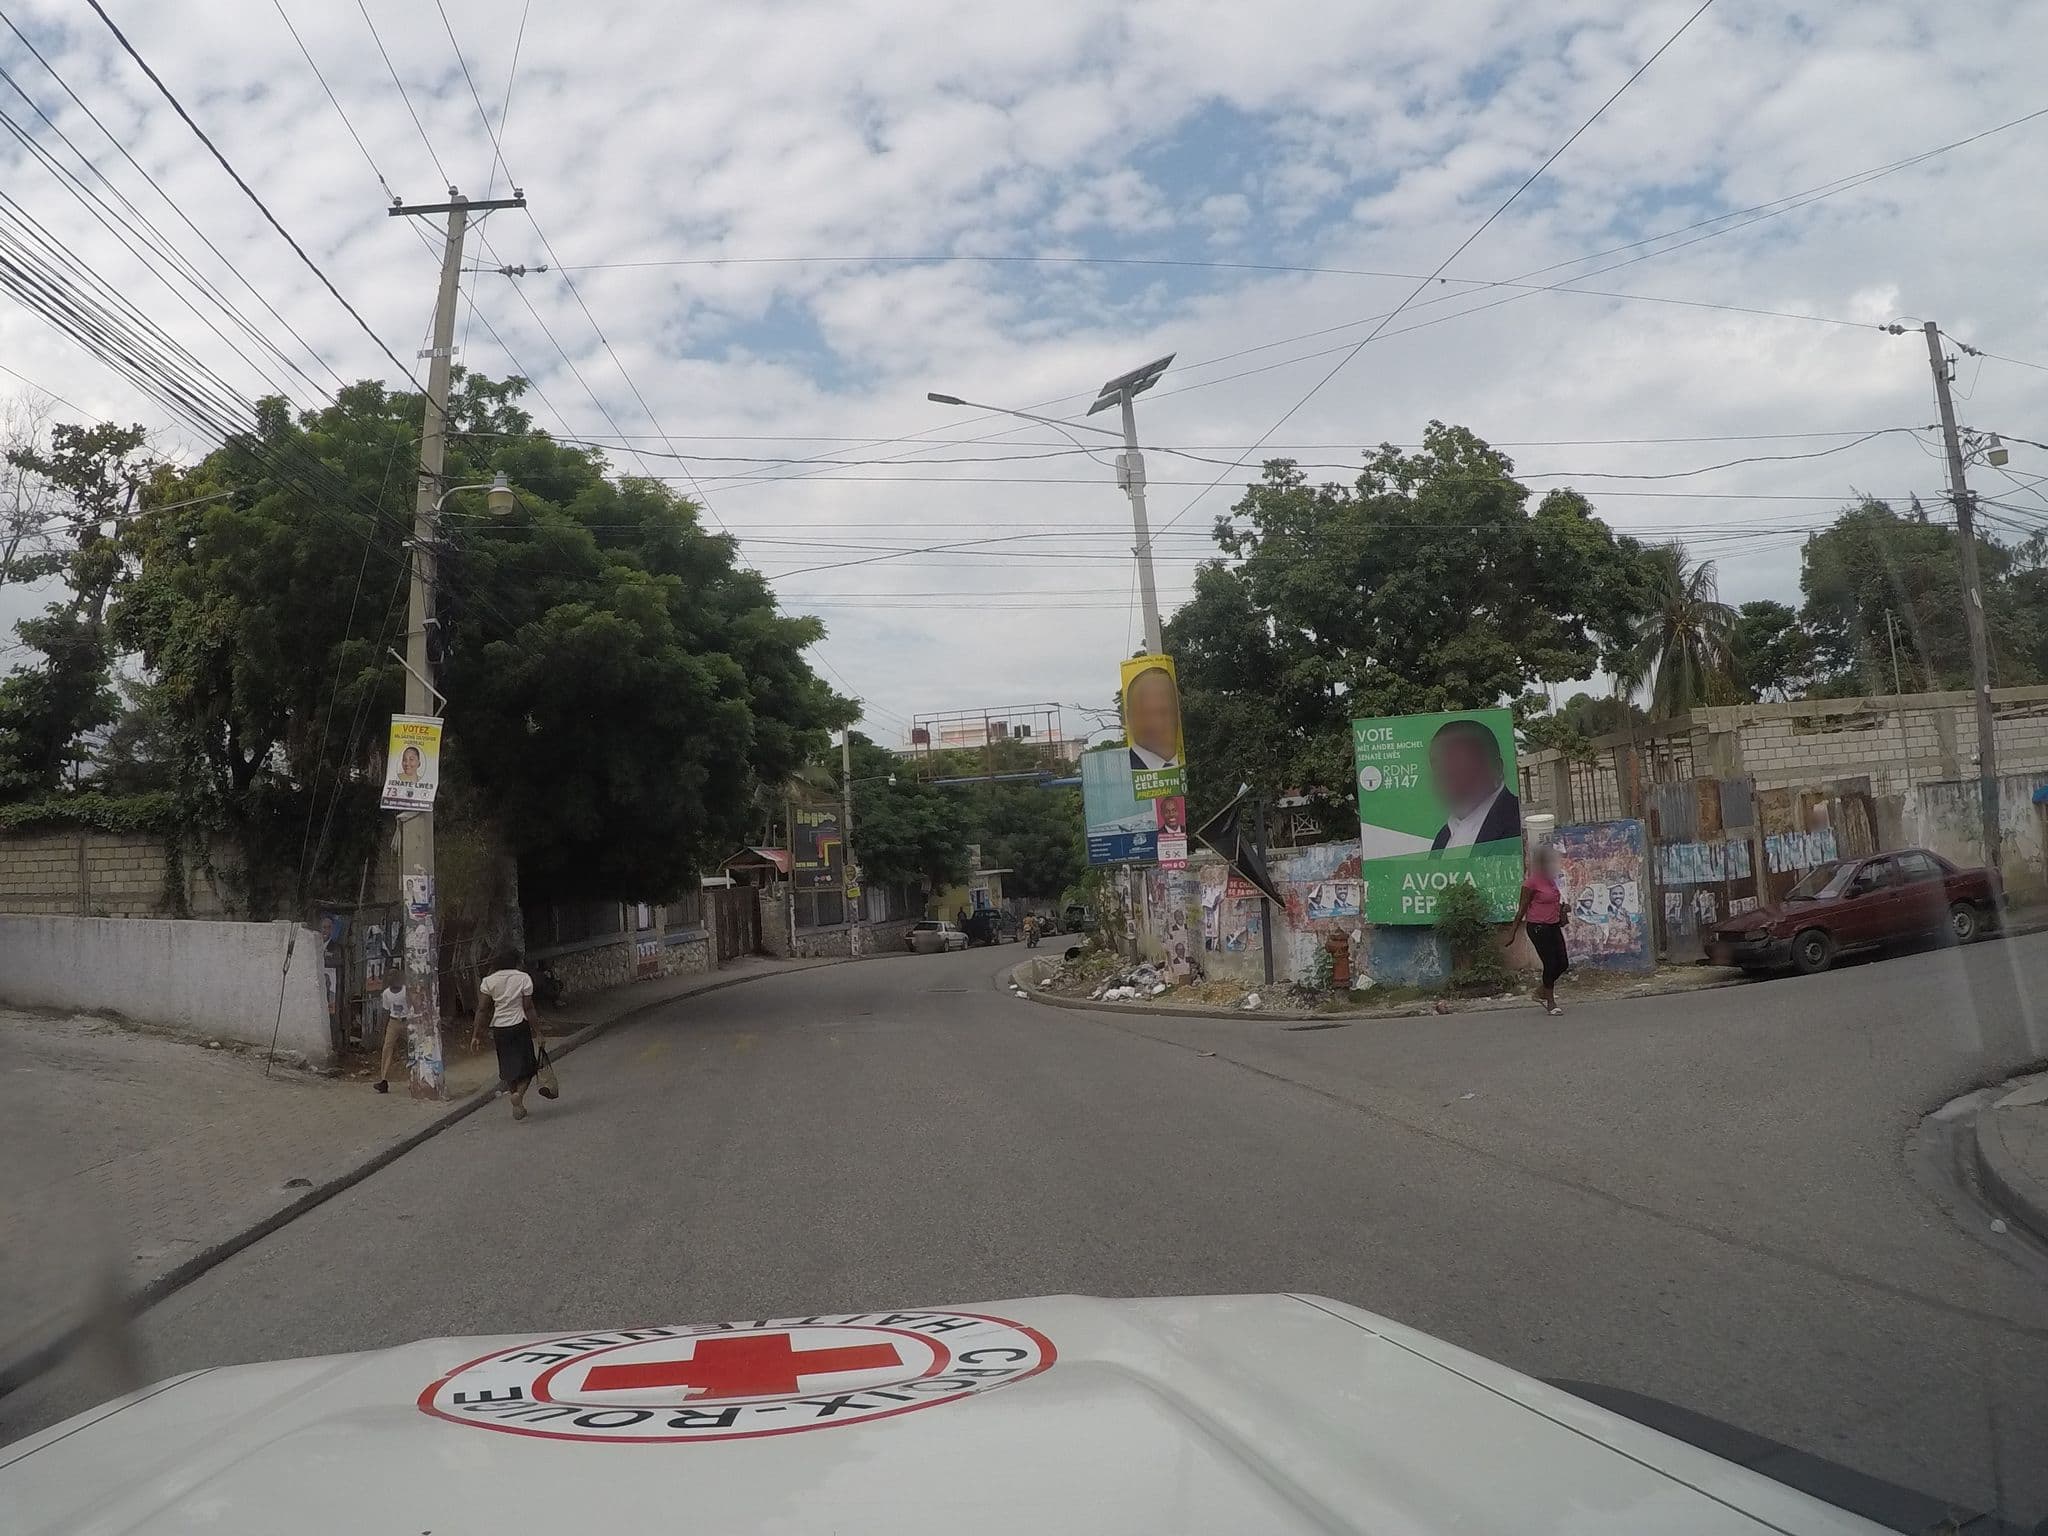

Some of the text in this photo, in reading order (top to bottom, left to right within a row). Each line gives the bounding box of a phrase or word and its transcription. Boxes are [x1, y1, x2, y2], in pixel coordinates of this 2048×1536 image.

[403, 724, 430, 734] VOTEZ
[1356, 727, 1394, 742] VOTE
[1396, 740, 1424, 750] MICHEL
[1383, 763, 1418, 777] RDNP
[1134, 772, 1159, 783] JUDE
[1135, 777, 1180, 791] CELESTIN
[1383, 775, 1419, 789] #147
[386, 787, 398, 797] 73
[1402, 871, 1477, 890] AVOKA
[1402, 890, 1438, 914] PÈP
[453, 1347, 1029, 1429] CROIX-ROUGE
